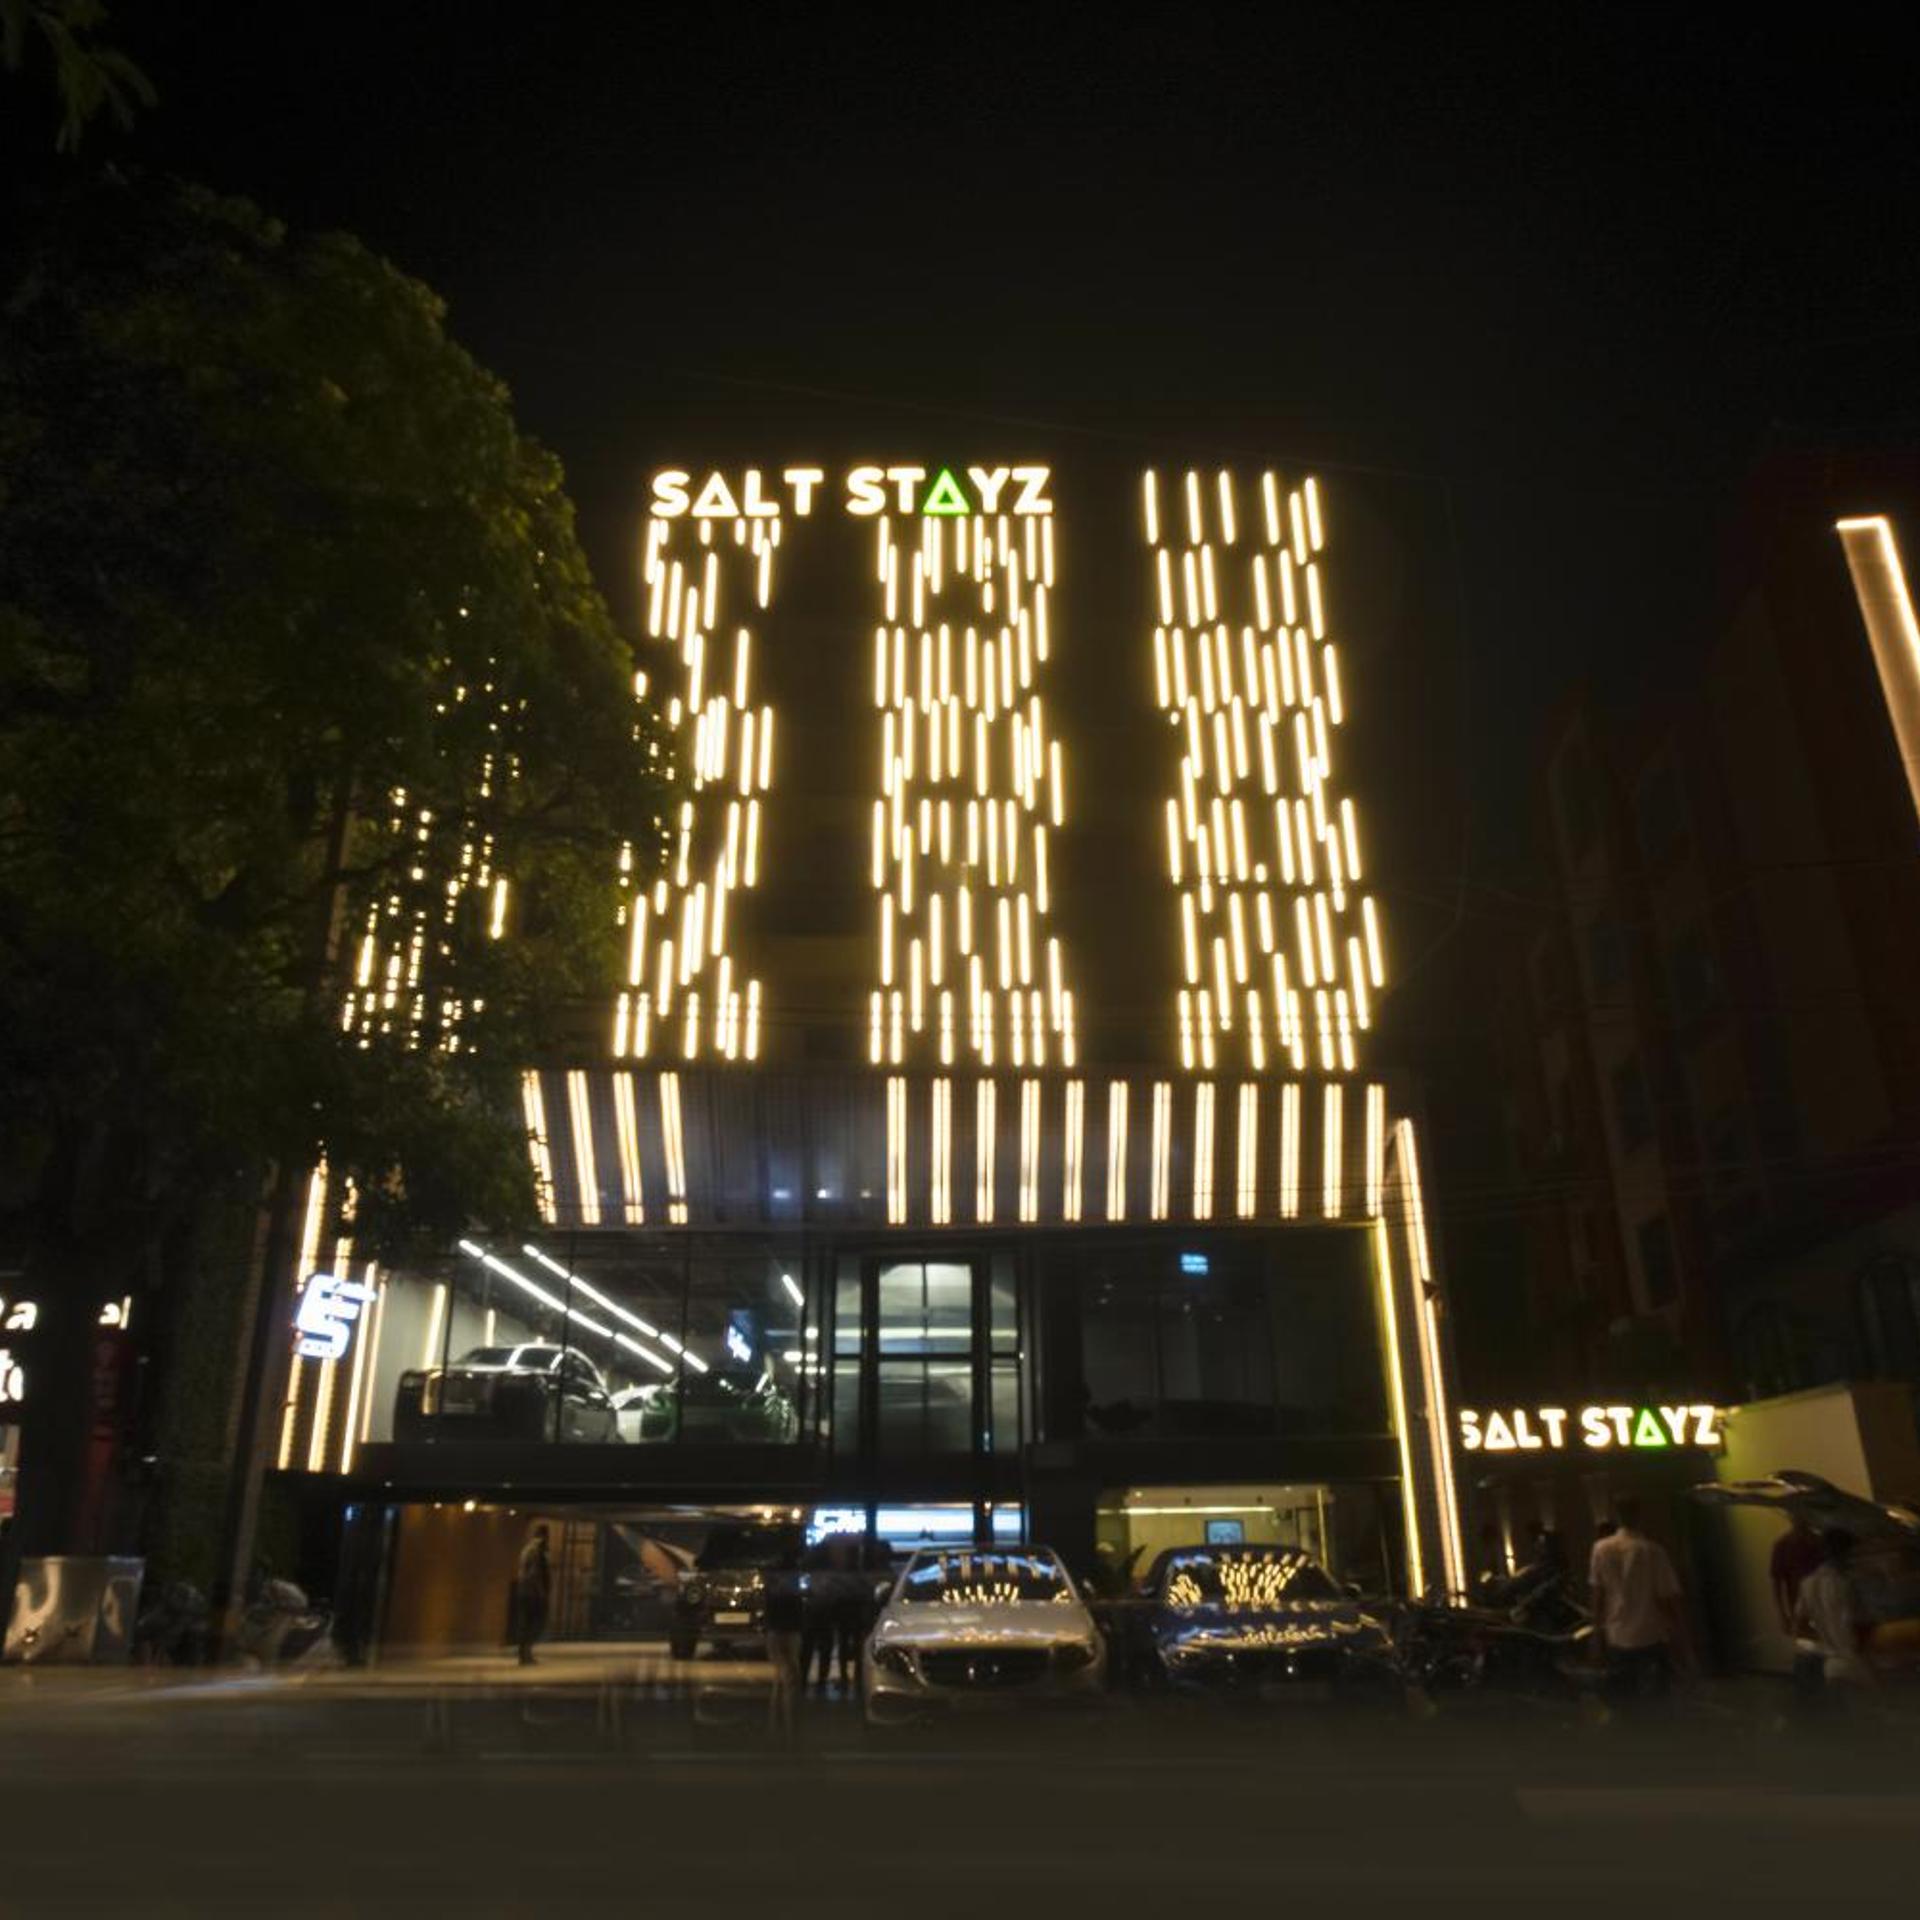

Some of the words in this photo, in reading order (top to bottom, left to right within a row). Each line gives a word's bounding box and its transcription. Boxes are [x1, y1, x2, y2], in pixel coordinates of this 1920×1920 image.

[650, 469, 824, 516] SALT
[845, 466, 1053, 514] STAYZ
[1460, 1408, 1567, 1450] SALT
[1580, 1405, 1721, 1447] STAYZ
